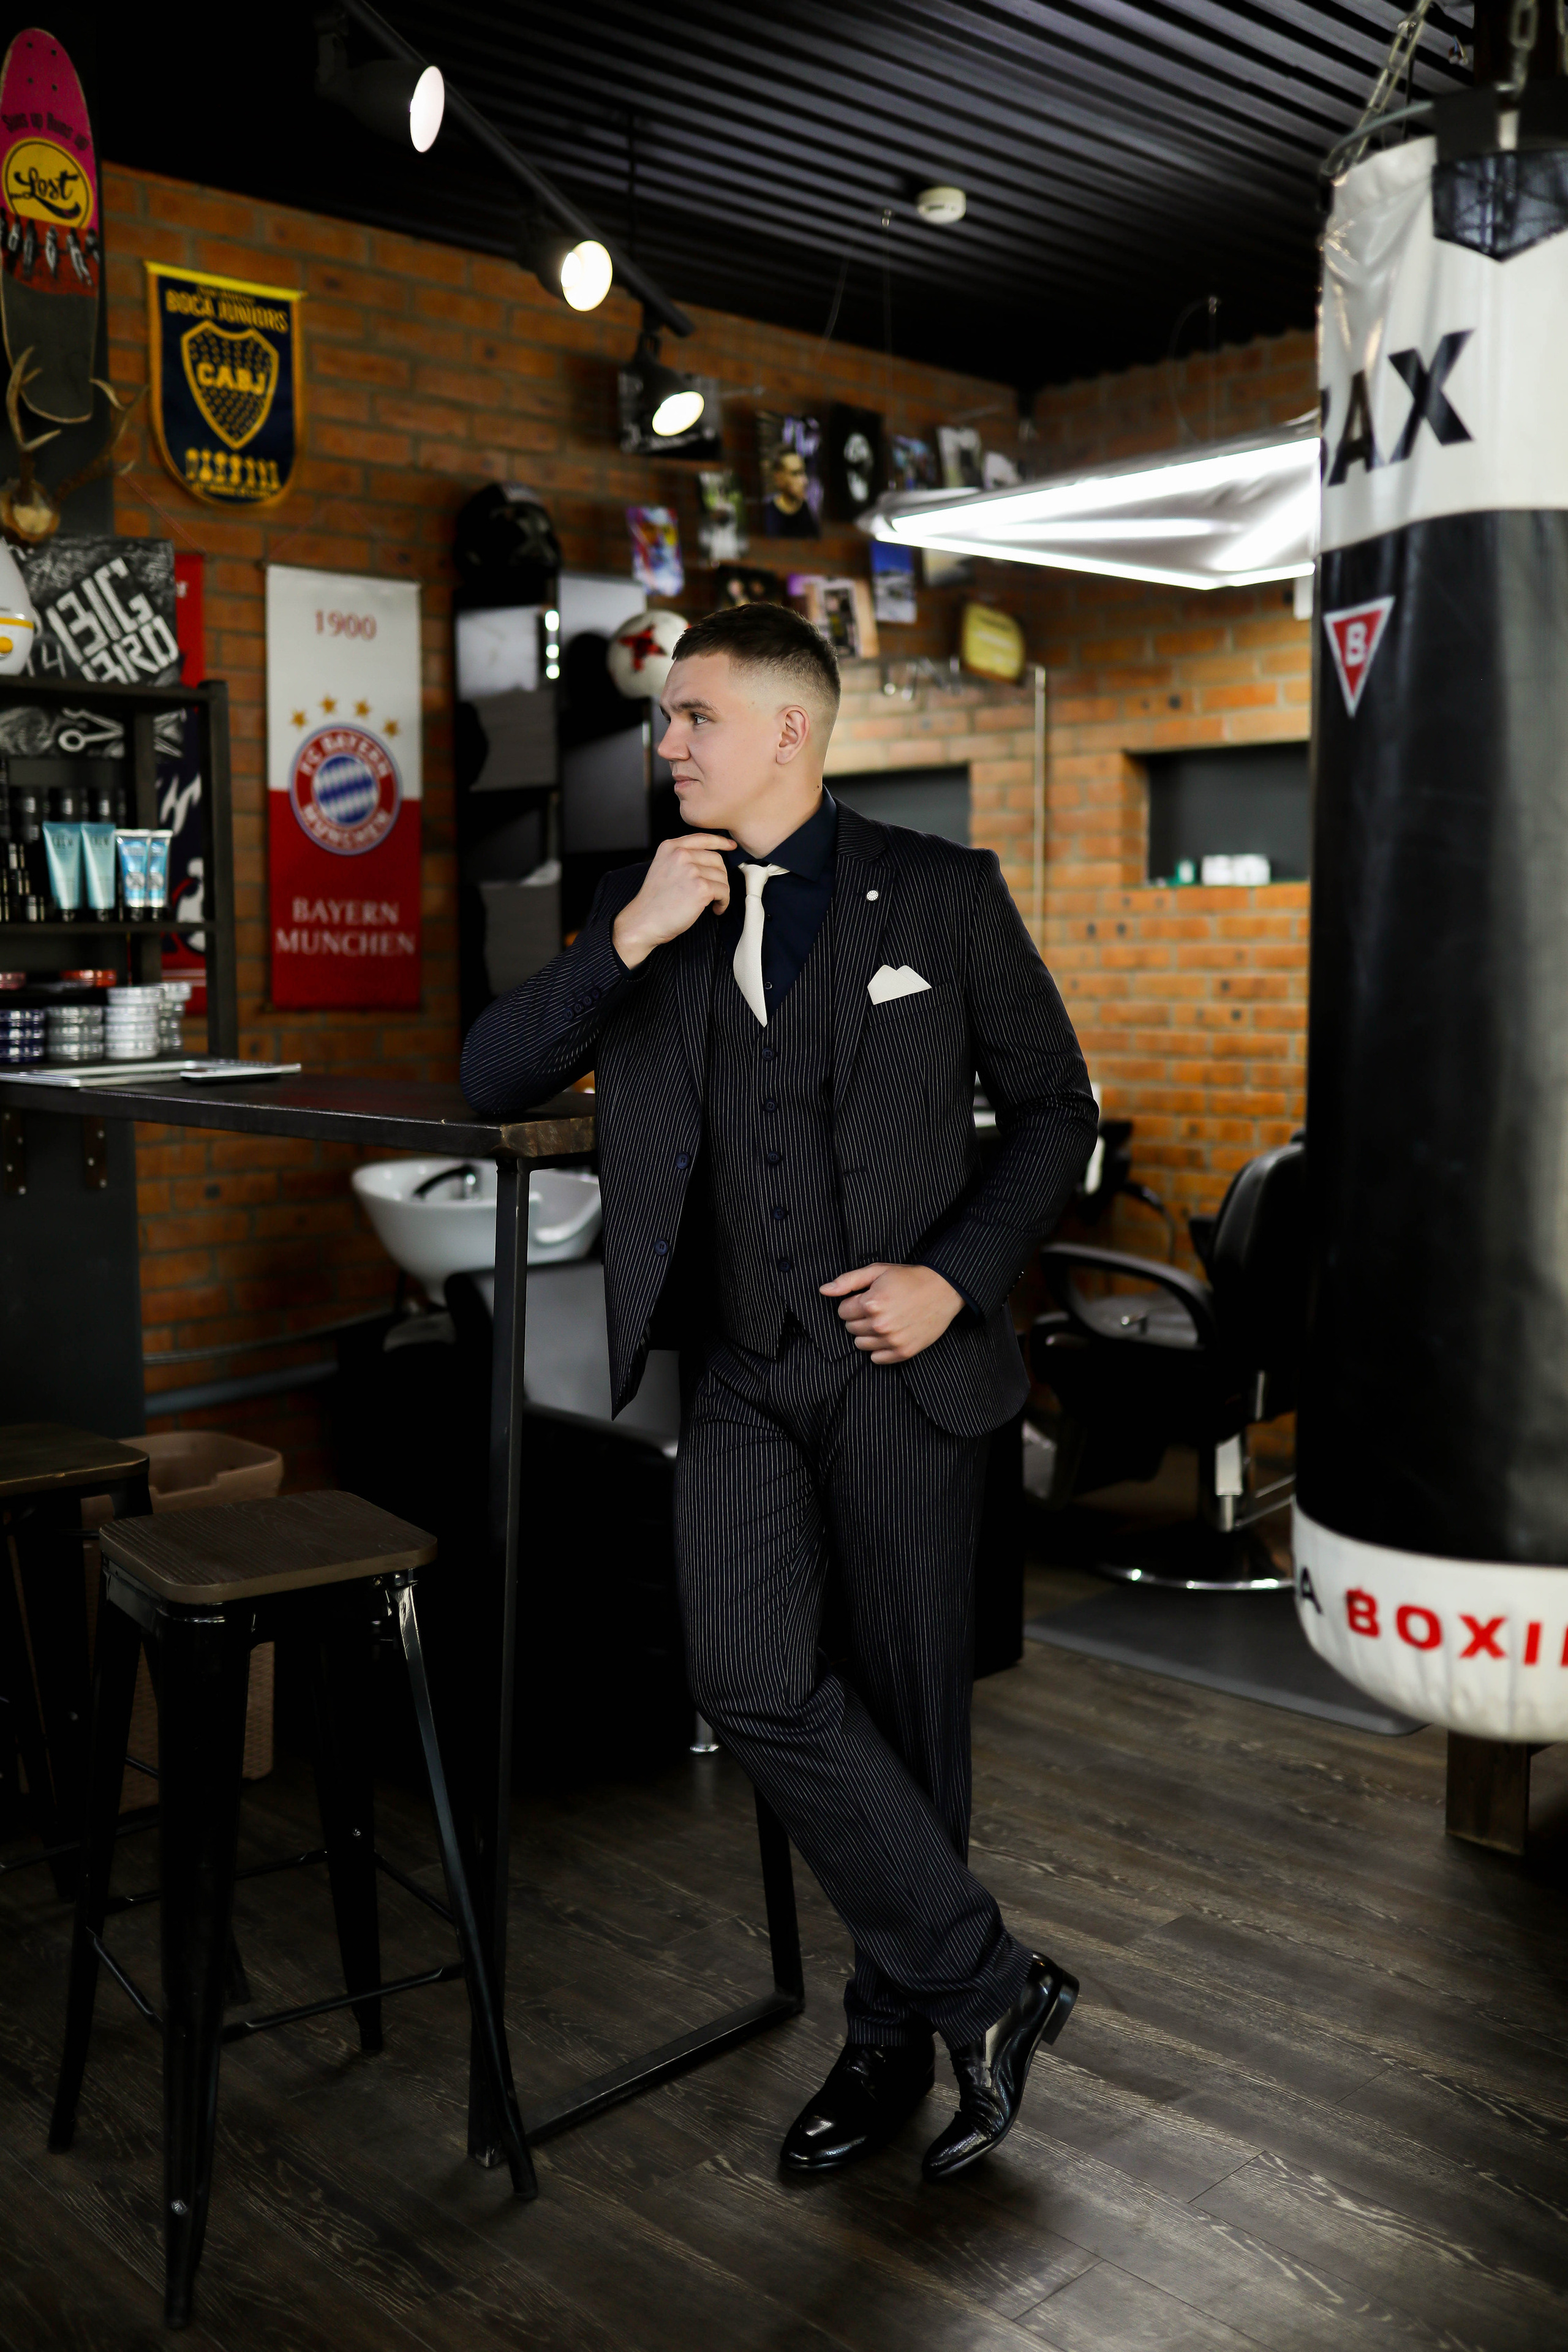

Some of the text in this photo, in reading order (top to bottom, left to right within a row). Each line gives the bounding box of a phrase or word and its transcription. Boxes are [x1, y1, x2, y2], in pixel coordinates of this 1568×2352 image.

[10, 167, 81, 219] Lost
[166, 289, 214, 318] BOCA
[217, 301, 288, 333] JUNIORS
[1319, 329, 1475, 487] AX
[315, 609, 377, 641] 1900
[292, 896, 399, 925] BAYERN
[1344, 1585, 1568, 1668] BOXI
